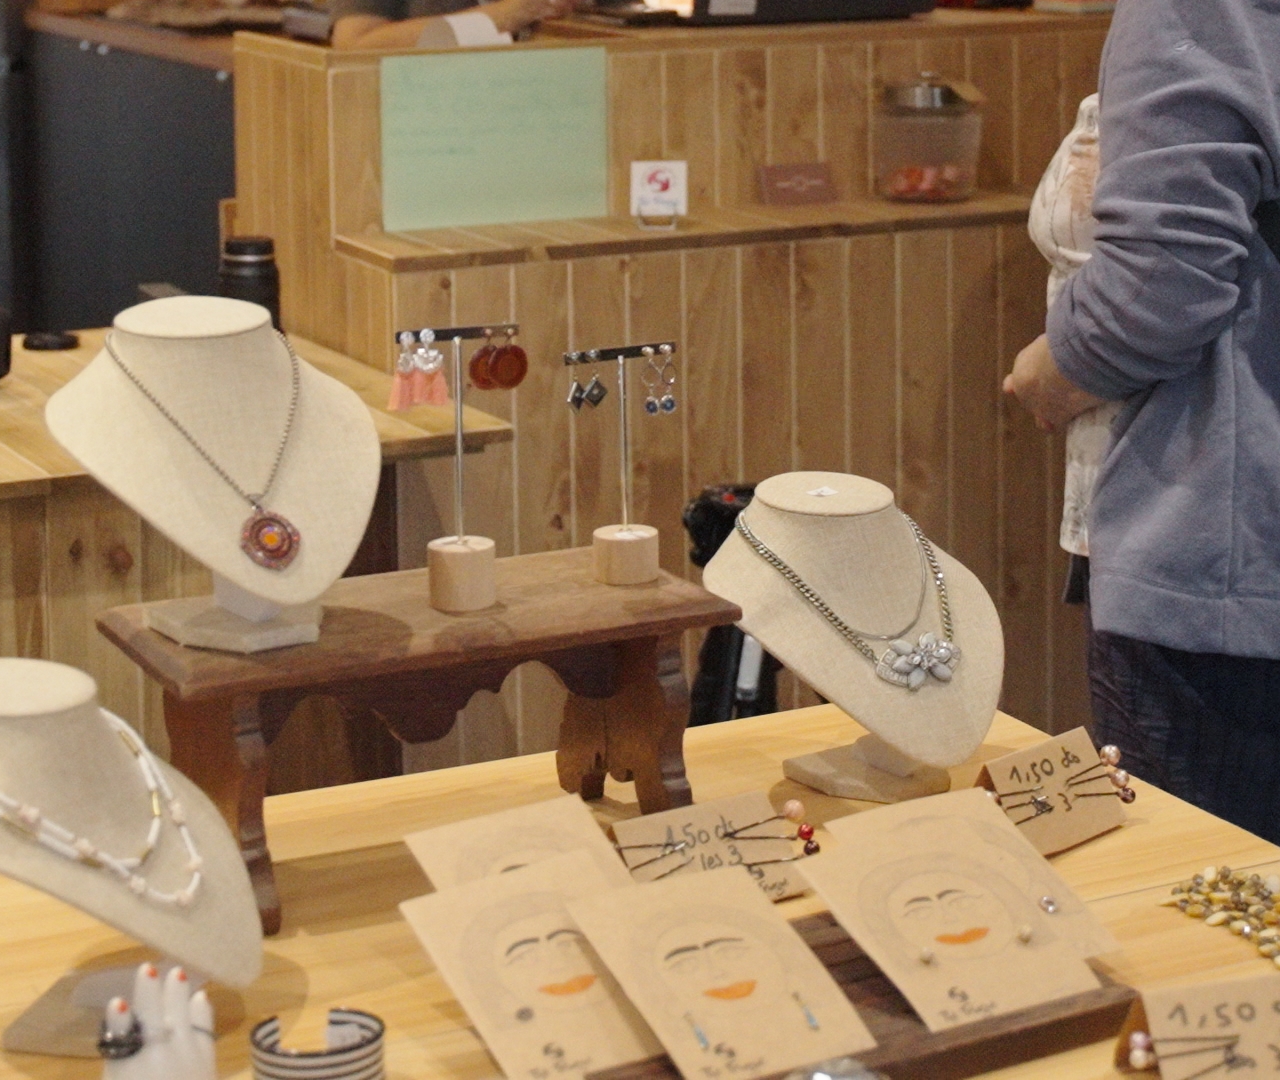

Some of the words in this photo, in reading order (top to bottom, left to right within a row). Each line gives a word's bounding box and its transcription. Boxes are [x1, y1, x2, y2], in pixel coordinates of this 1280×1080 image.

[1008, 758, 1055, 784] 1,50
[700, 851, 724, 871] les
[1167, 1001, 1257, 1030] 1,50
